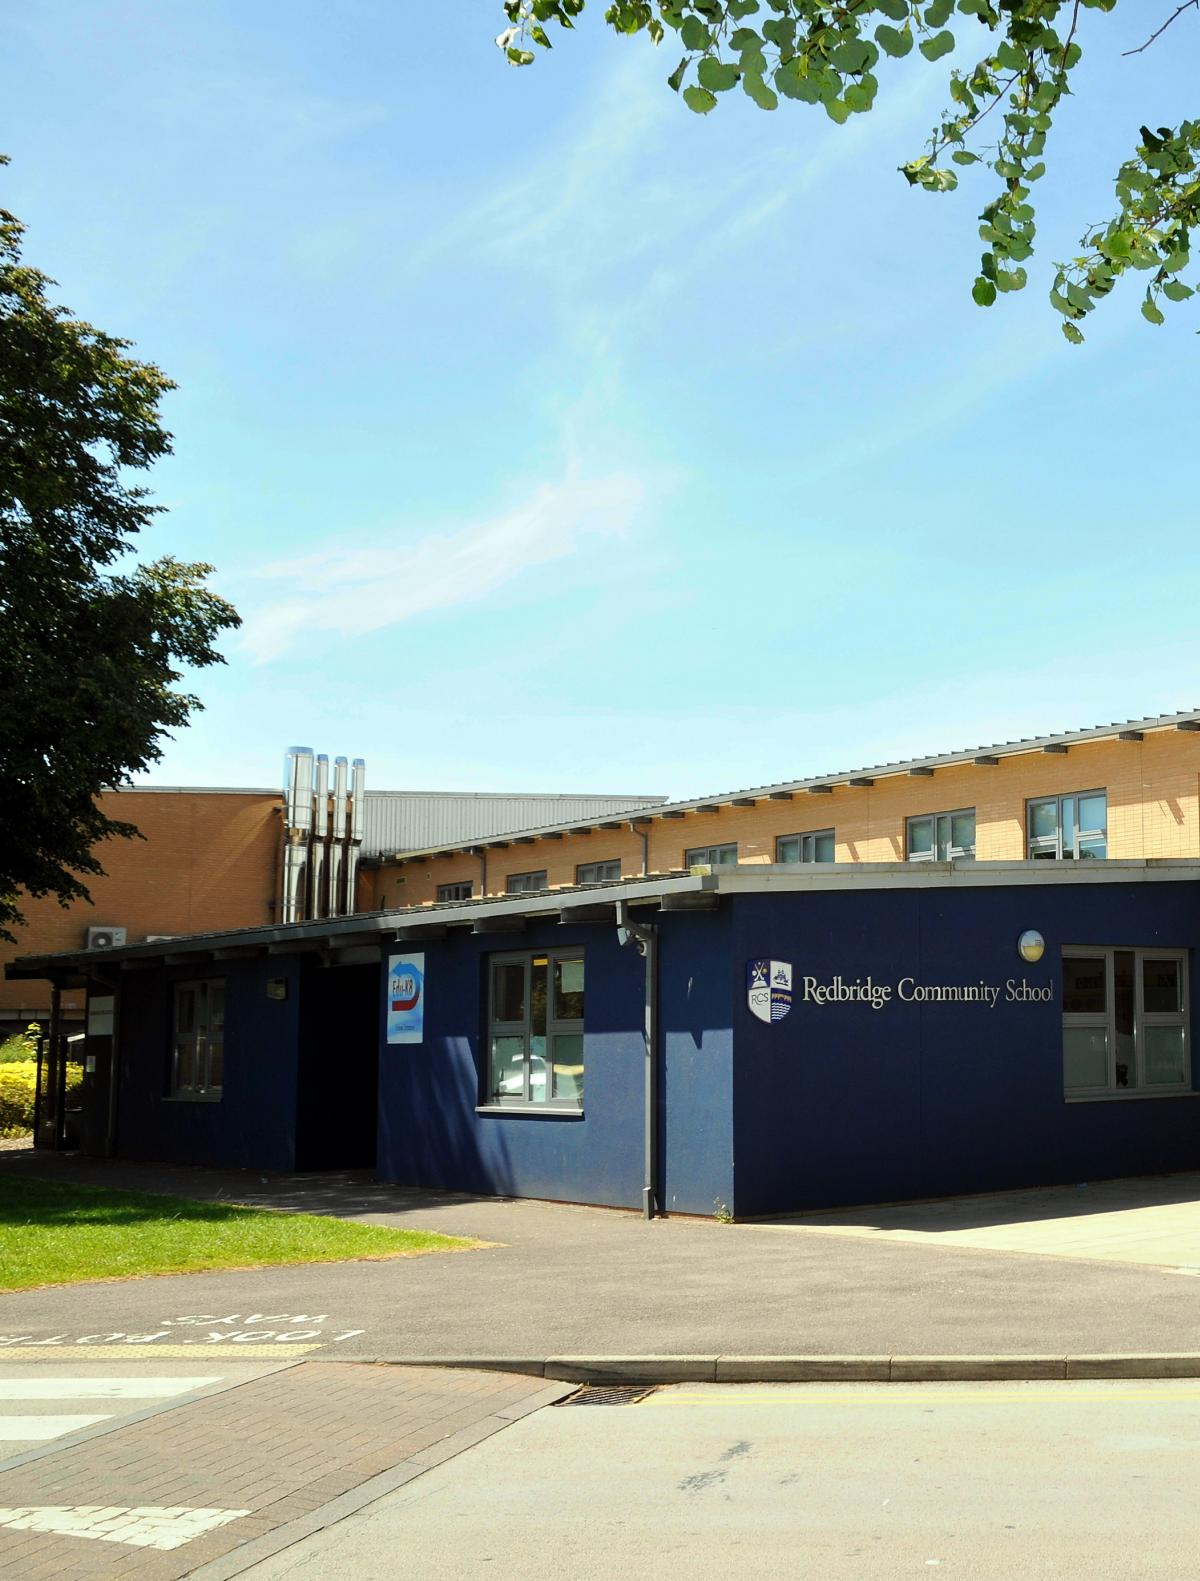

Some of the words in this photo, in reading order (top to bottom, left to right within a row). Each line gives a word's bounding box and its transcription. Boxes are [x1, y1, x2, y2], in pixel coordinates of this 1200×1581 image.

[803, 975, 892, 1008] Redbridge
[898, 978, 1000, 1008] Community
[1005, 978, 1055, 1002] School
[751, 992, 769, 1006] RCS
[161, 1313, 329, 1325] WAYS
[190, 1329, 365, 1343] LOOK
